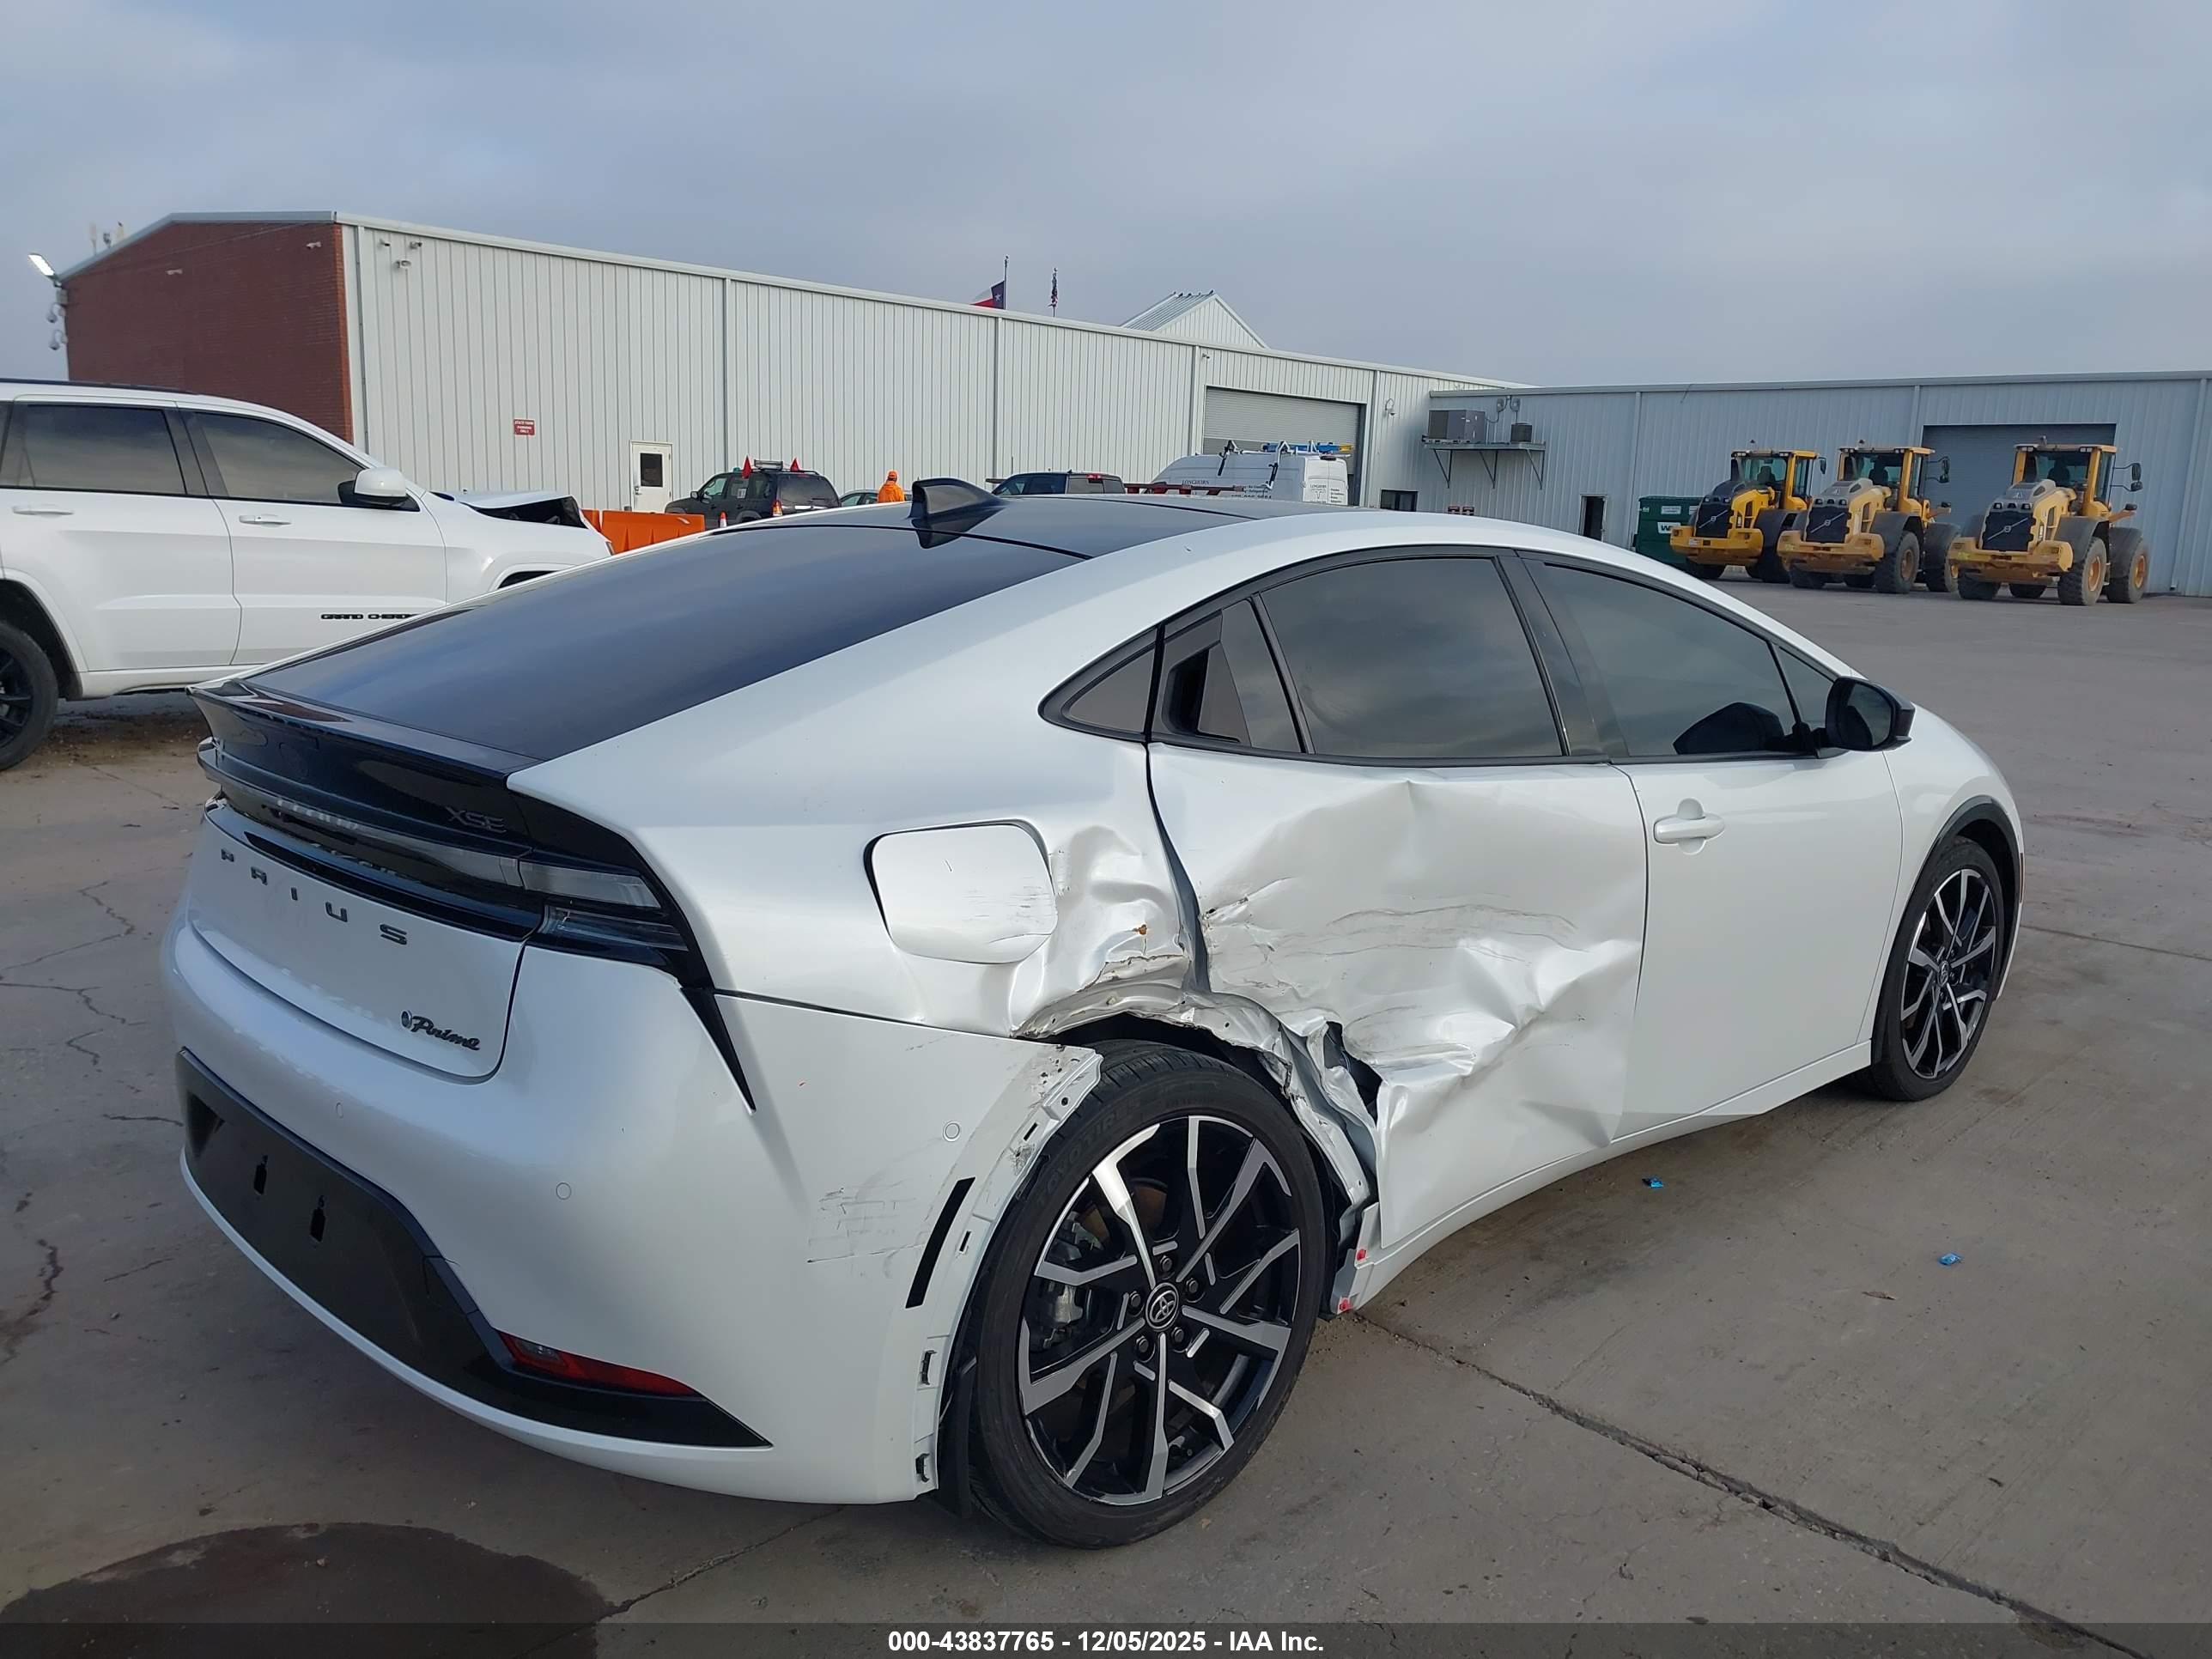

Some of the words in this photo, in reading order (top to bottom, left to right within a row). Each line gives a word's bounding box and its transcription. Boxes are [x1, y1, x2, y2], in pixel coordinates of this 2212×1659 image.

[446, 806, 507, 834] XSE
[221, 848, 407, 945] PRIUS
[410, 1016, 480, 1050] Prime
